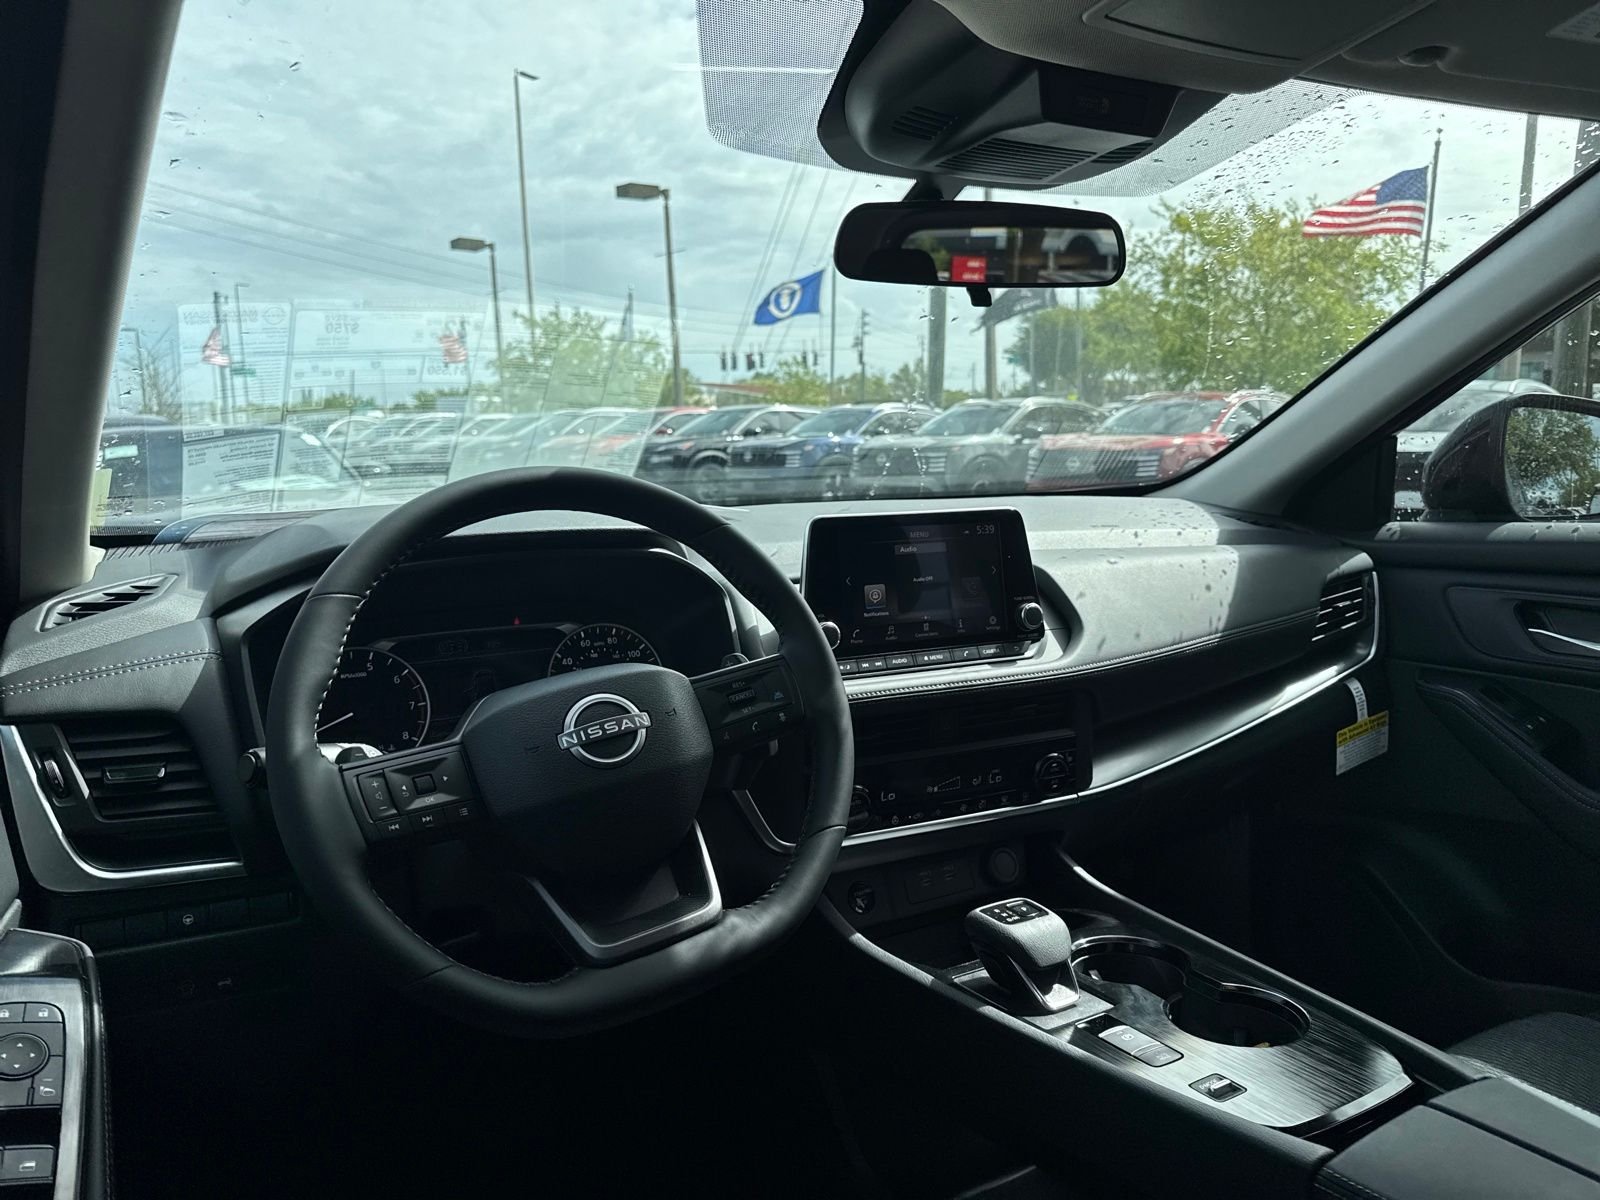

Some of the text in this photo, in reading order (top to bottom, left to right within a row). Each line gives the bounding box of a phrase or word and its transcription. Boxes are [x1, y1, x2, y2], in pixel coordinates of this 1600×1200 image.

[976, 523, 995, 536] 5:39
[909, 530, 930, 539] MENU
[899, 545, 918, 553] Audio
[580, 639, 591, 648] 60
[607, 637, 618, 645] 80
[627, 649, 641, 658] 100
[982, 647, 1001, 655] CAMERA
[562, 657, 573, 665] 40
[892, 656, 908, 665] AUDIO
[928, 653, 944, 661] MENU
[366, 662, 375, 671] 5
[393, 676, 401, 684] 6
[409, 701, 416, 711] 7
[402, 731, 410, 740] 8
[561, 715, 650, 747] NISSAN
[880, 790, 897, 802] Lo
